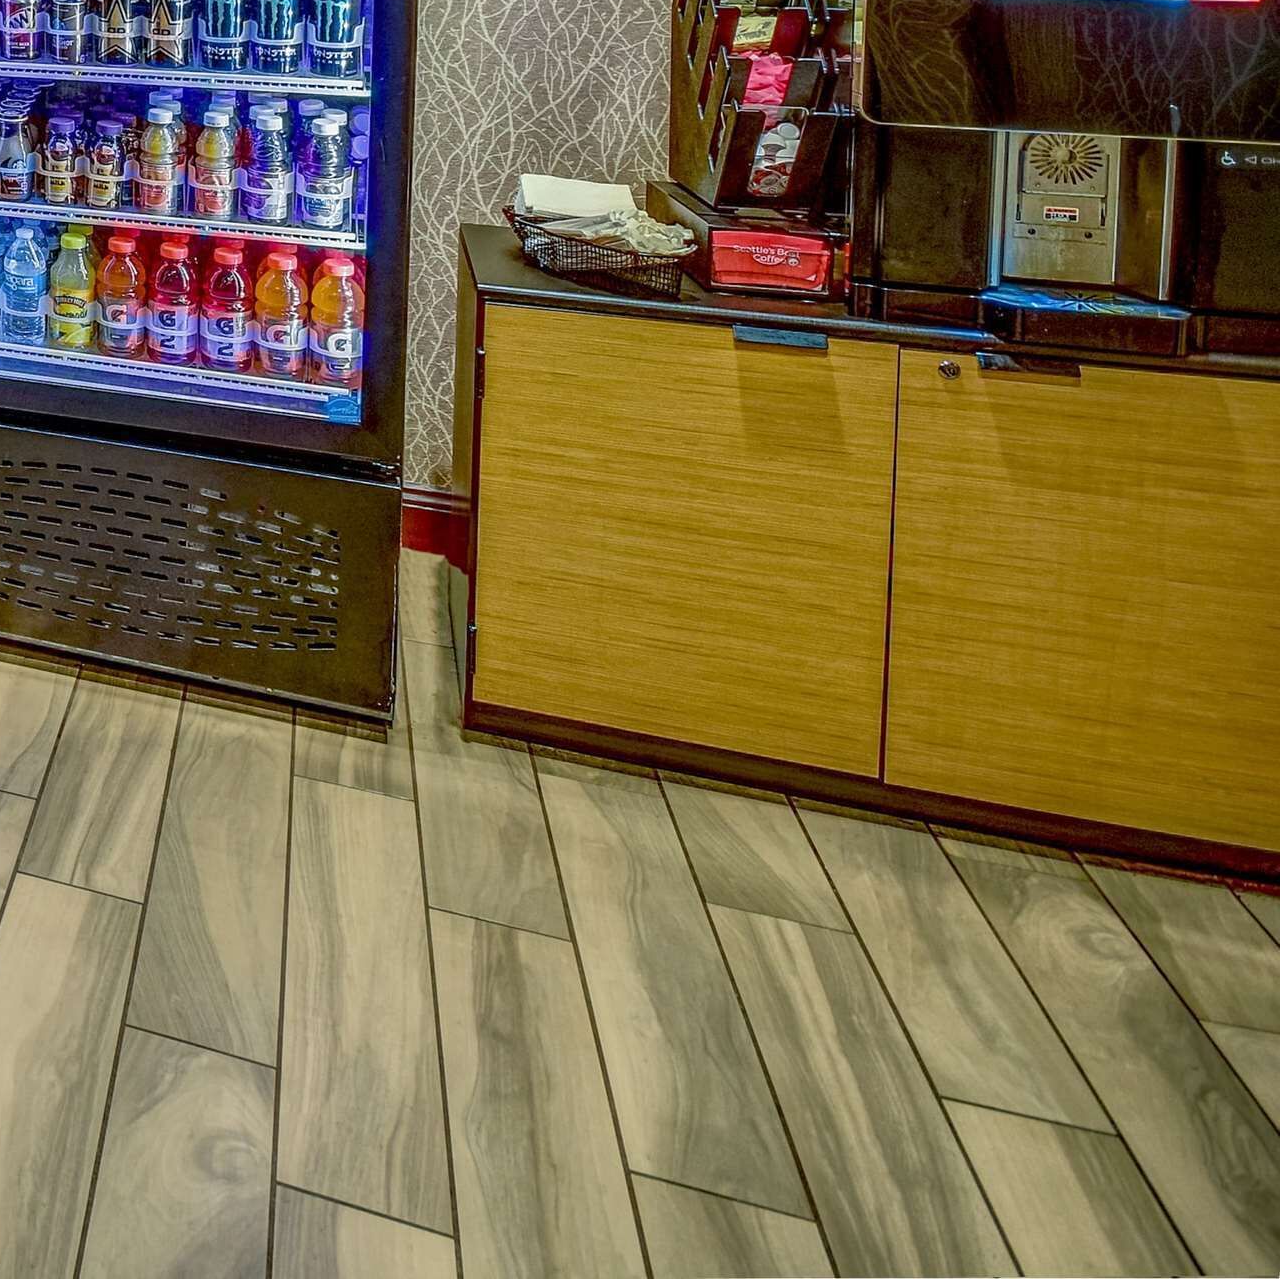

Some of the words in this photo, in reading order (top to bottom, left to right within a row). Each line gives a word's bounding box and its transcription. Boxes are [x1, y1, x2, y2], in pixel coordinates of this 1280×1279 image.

[159, 310, 176, 328] G
[215, 317, 233, 335] G
[160, 334, 176, 350] 2
[217, 342, 233, 357] 2
[327, 333, 353, 356] G
